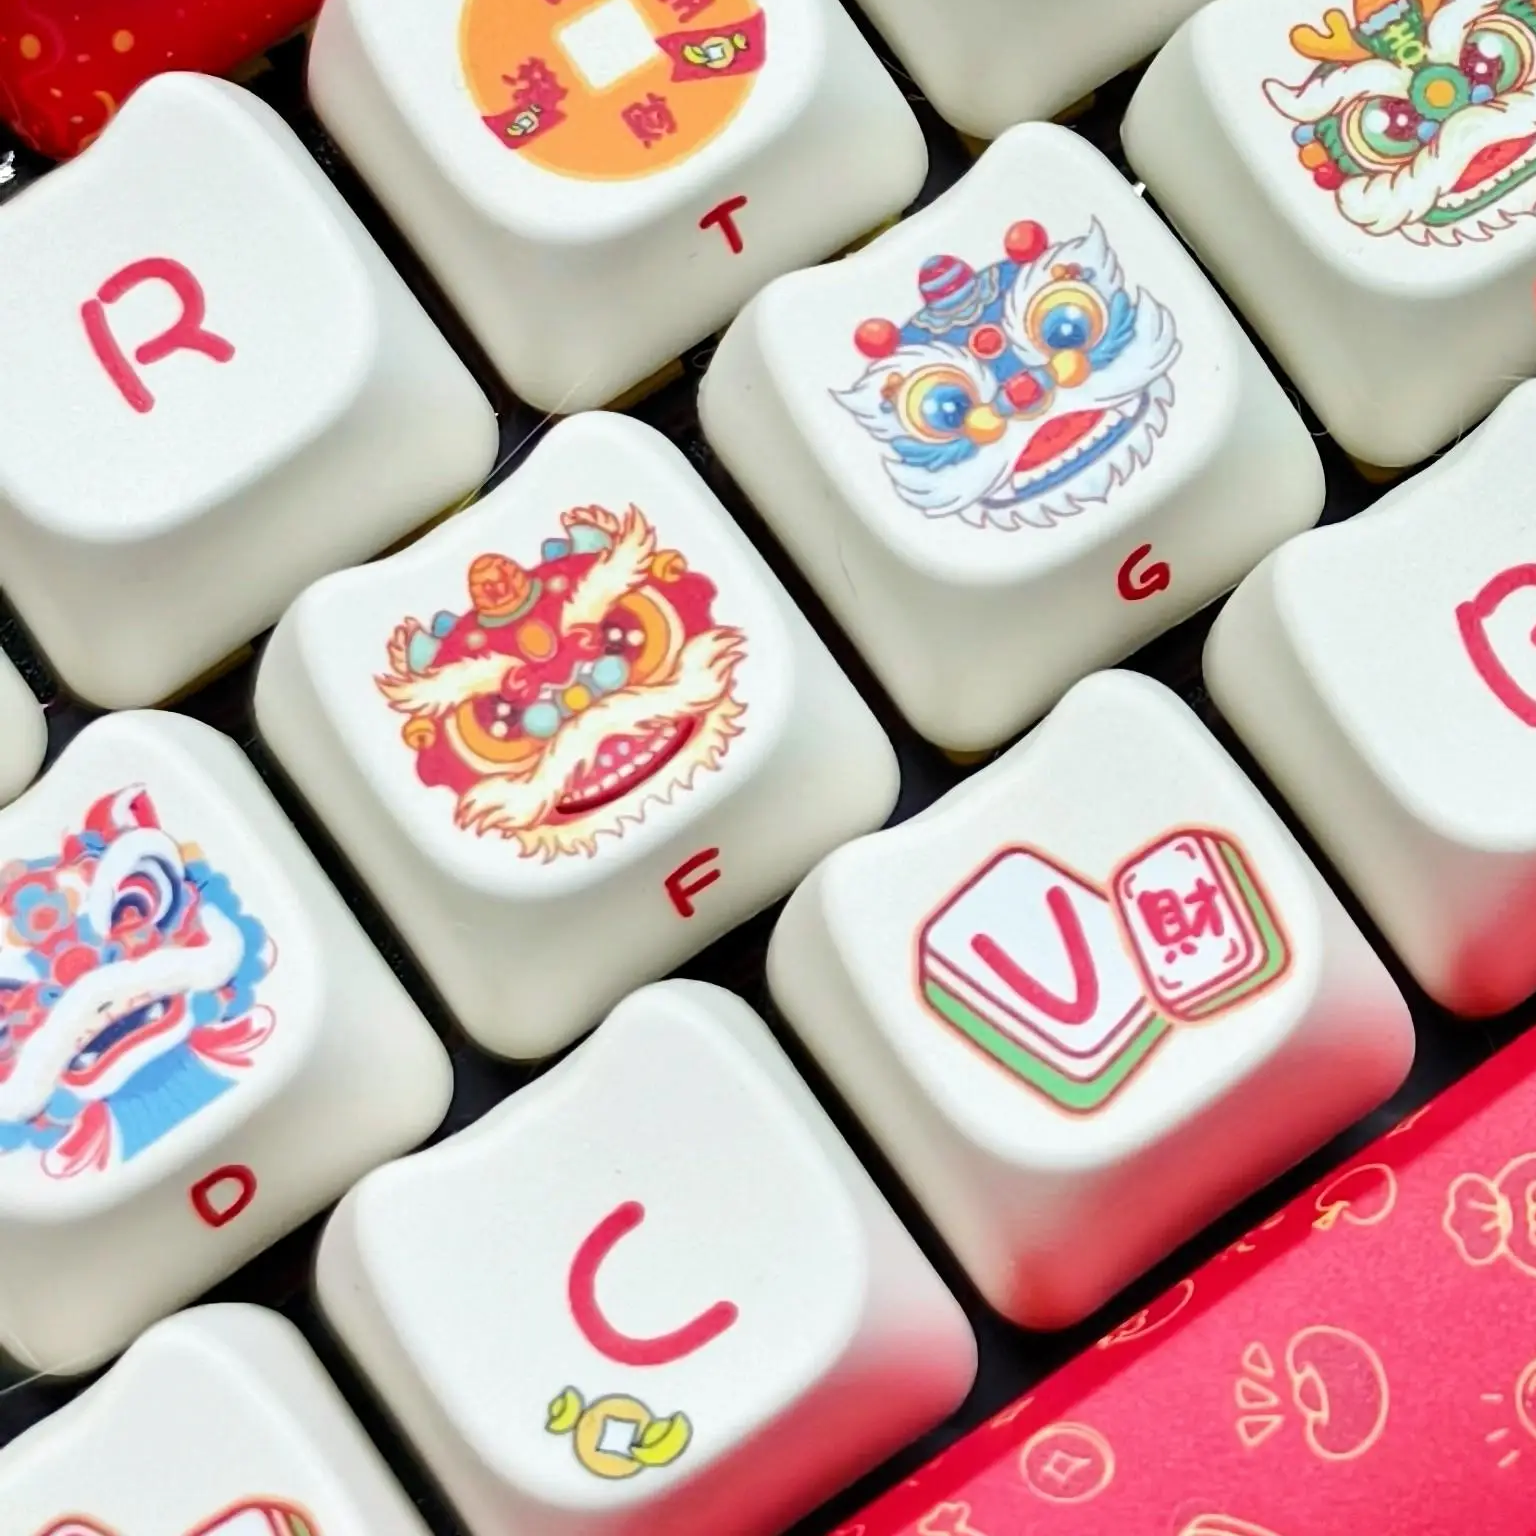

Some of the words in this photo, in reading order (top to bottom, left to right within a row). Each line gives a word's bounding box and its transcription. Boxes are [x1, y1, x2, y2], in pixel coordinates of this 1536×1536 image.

[699, 195, 748, 254] T
[80, 256, 236, 414] R
[1116, 544, 1171, 602] G
[664, 847, 721, 918] F
[971, 886, 1098, 1026] V
[188, 1164, 257, 1229] D
[566, 1201, 738, 1368] C
